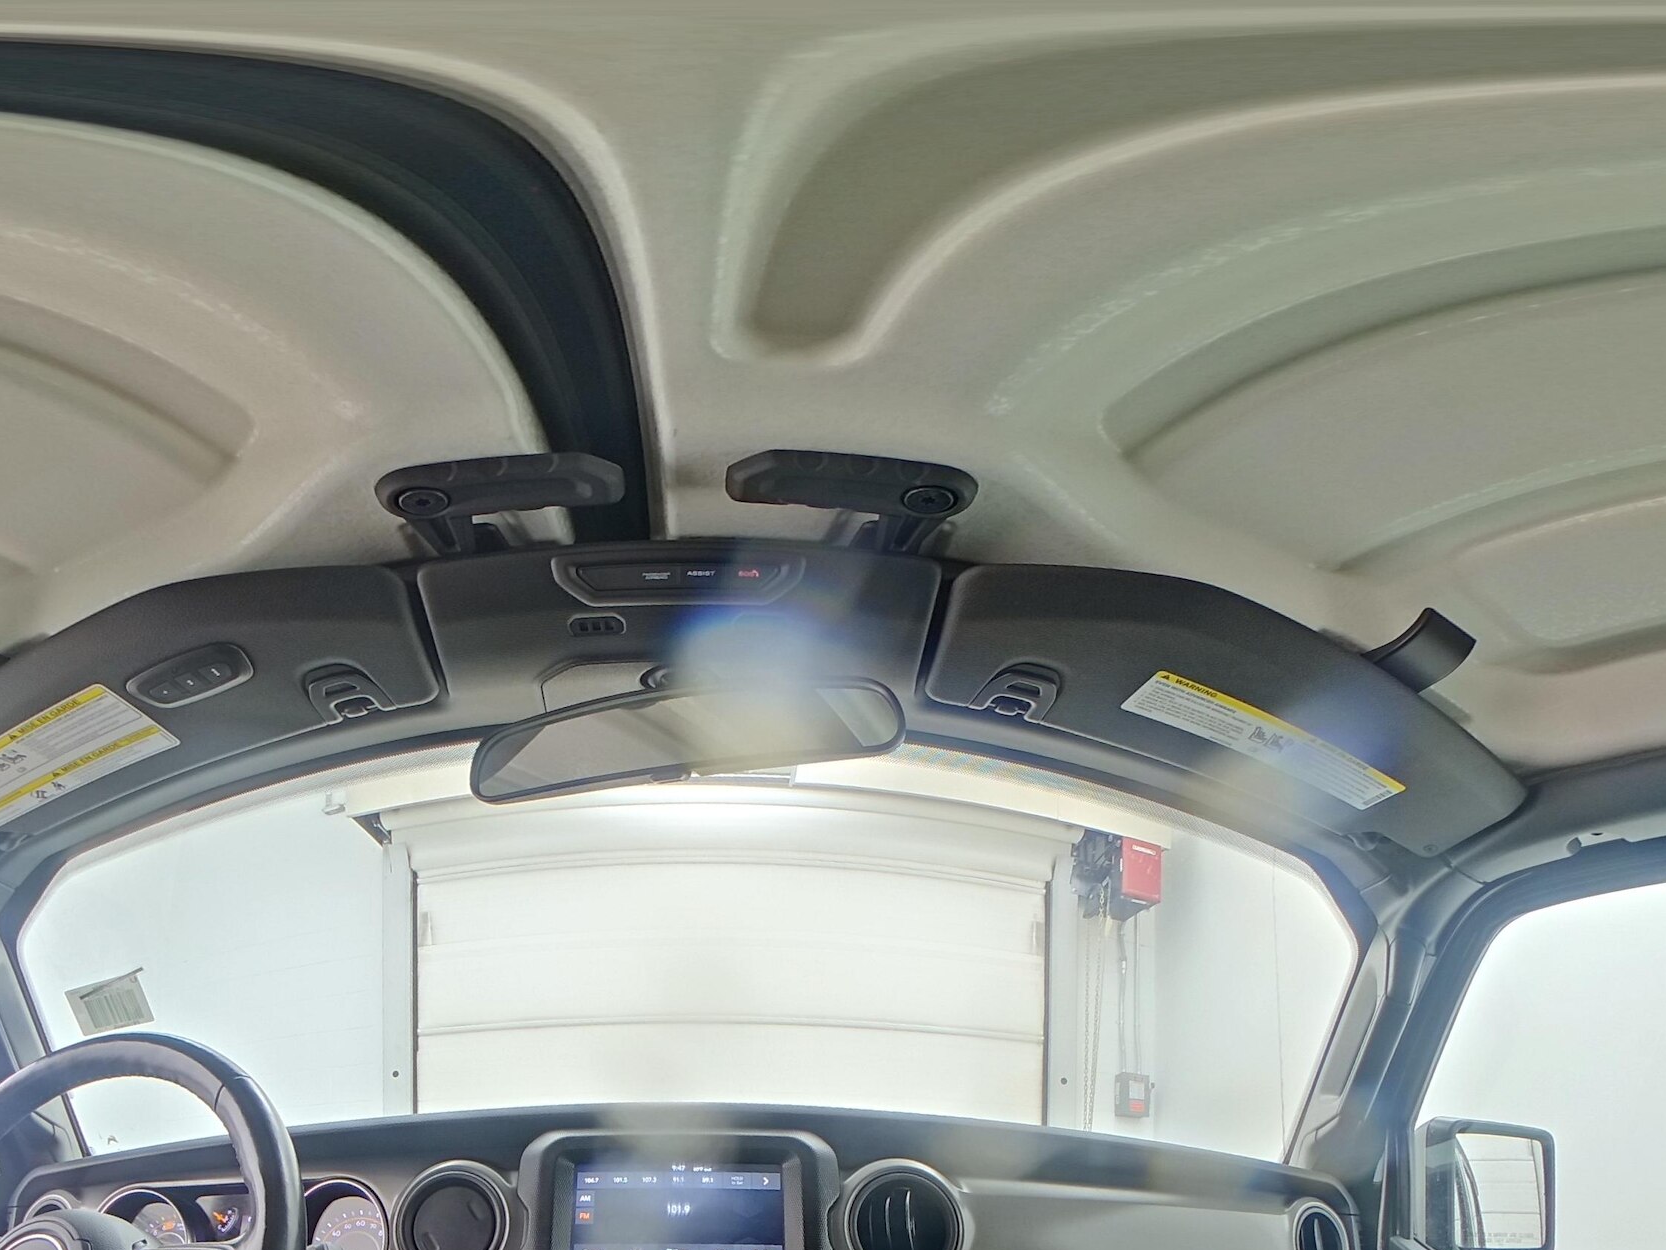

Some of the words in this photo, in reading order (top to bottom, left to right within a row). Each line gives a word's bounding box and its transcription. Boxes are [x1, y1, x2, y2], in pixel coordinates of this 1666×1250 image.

[1174, 677, 1218, 699] WARNING
[36, 713, 50, 725] EN
[49, 698, 81, 720] GARDE
[60, 760, 79, 773] MISE
[80, 754, 93, 765] EN
[92, 741, 121, 759] GARDE
[671, 1164, 686, 1172] 9:47
[579, 1212, 590, 1220] FM
[667, 1203, 691, 1215] 101.9
